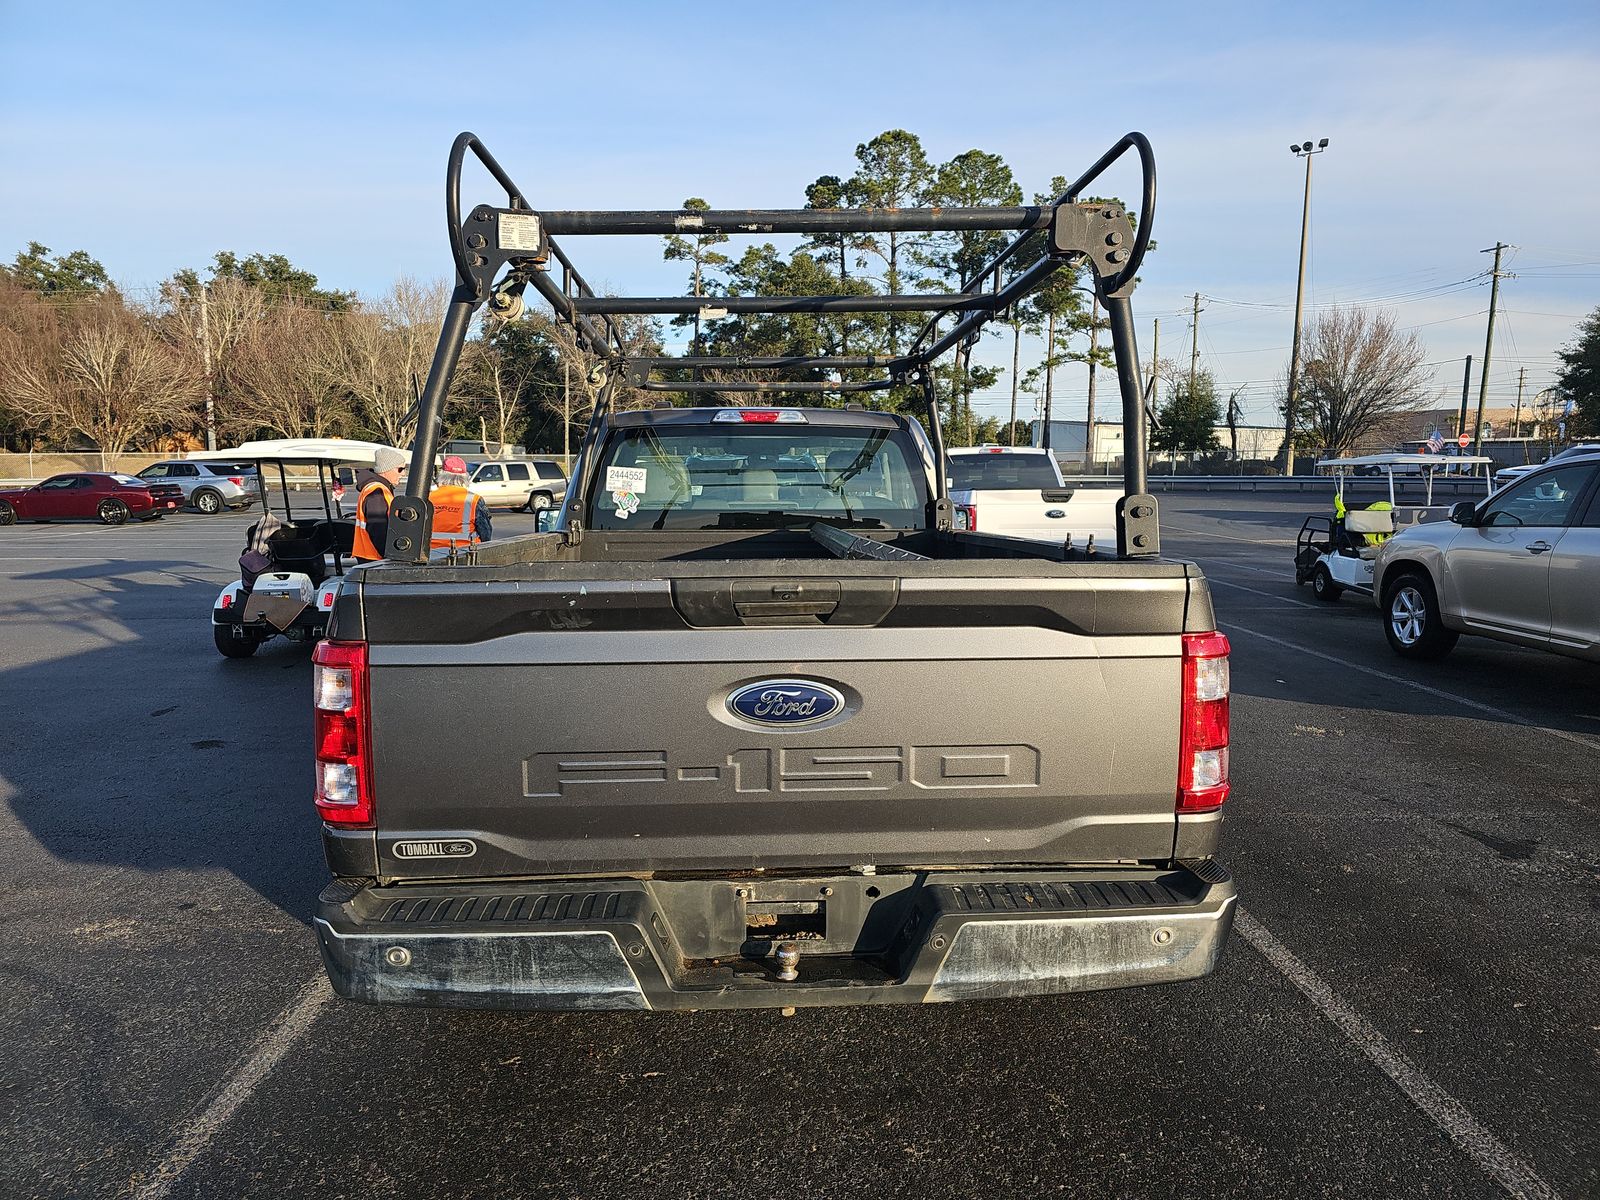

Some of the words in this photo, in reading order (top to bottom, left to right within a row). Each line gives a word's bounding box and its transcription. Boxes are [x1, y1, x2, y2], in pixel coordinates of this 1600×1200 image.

[610, 470, 644, 480] 2444552
[754, 689, 817, 715] Ford
[522, 743, 1040, 797] F-150
[400, 843, 445, 856] TOMBALL
